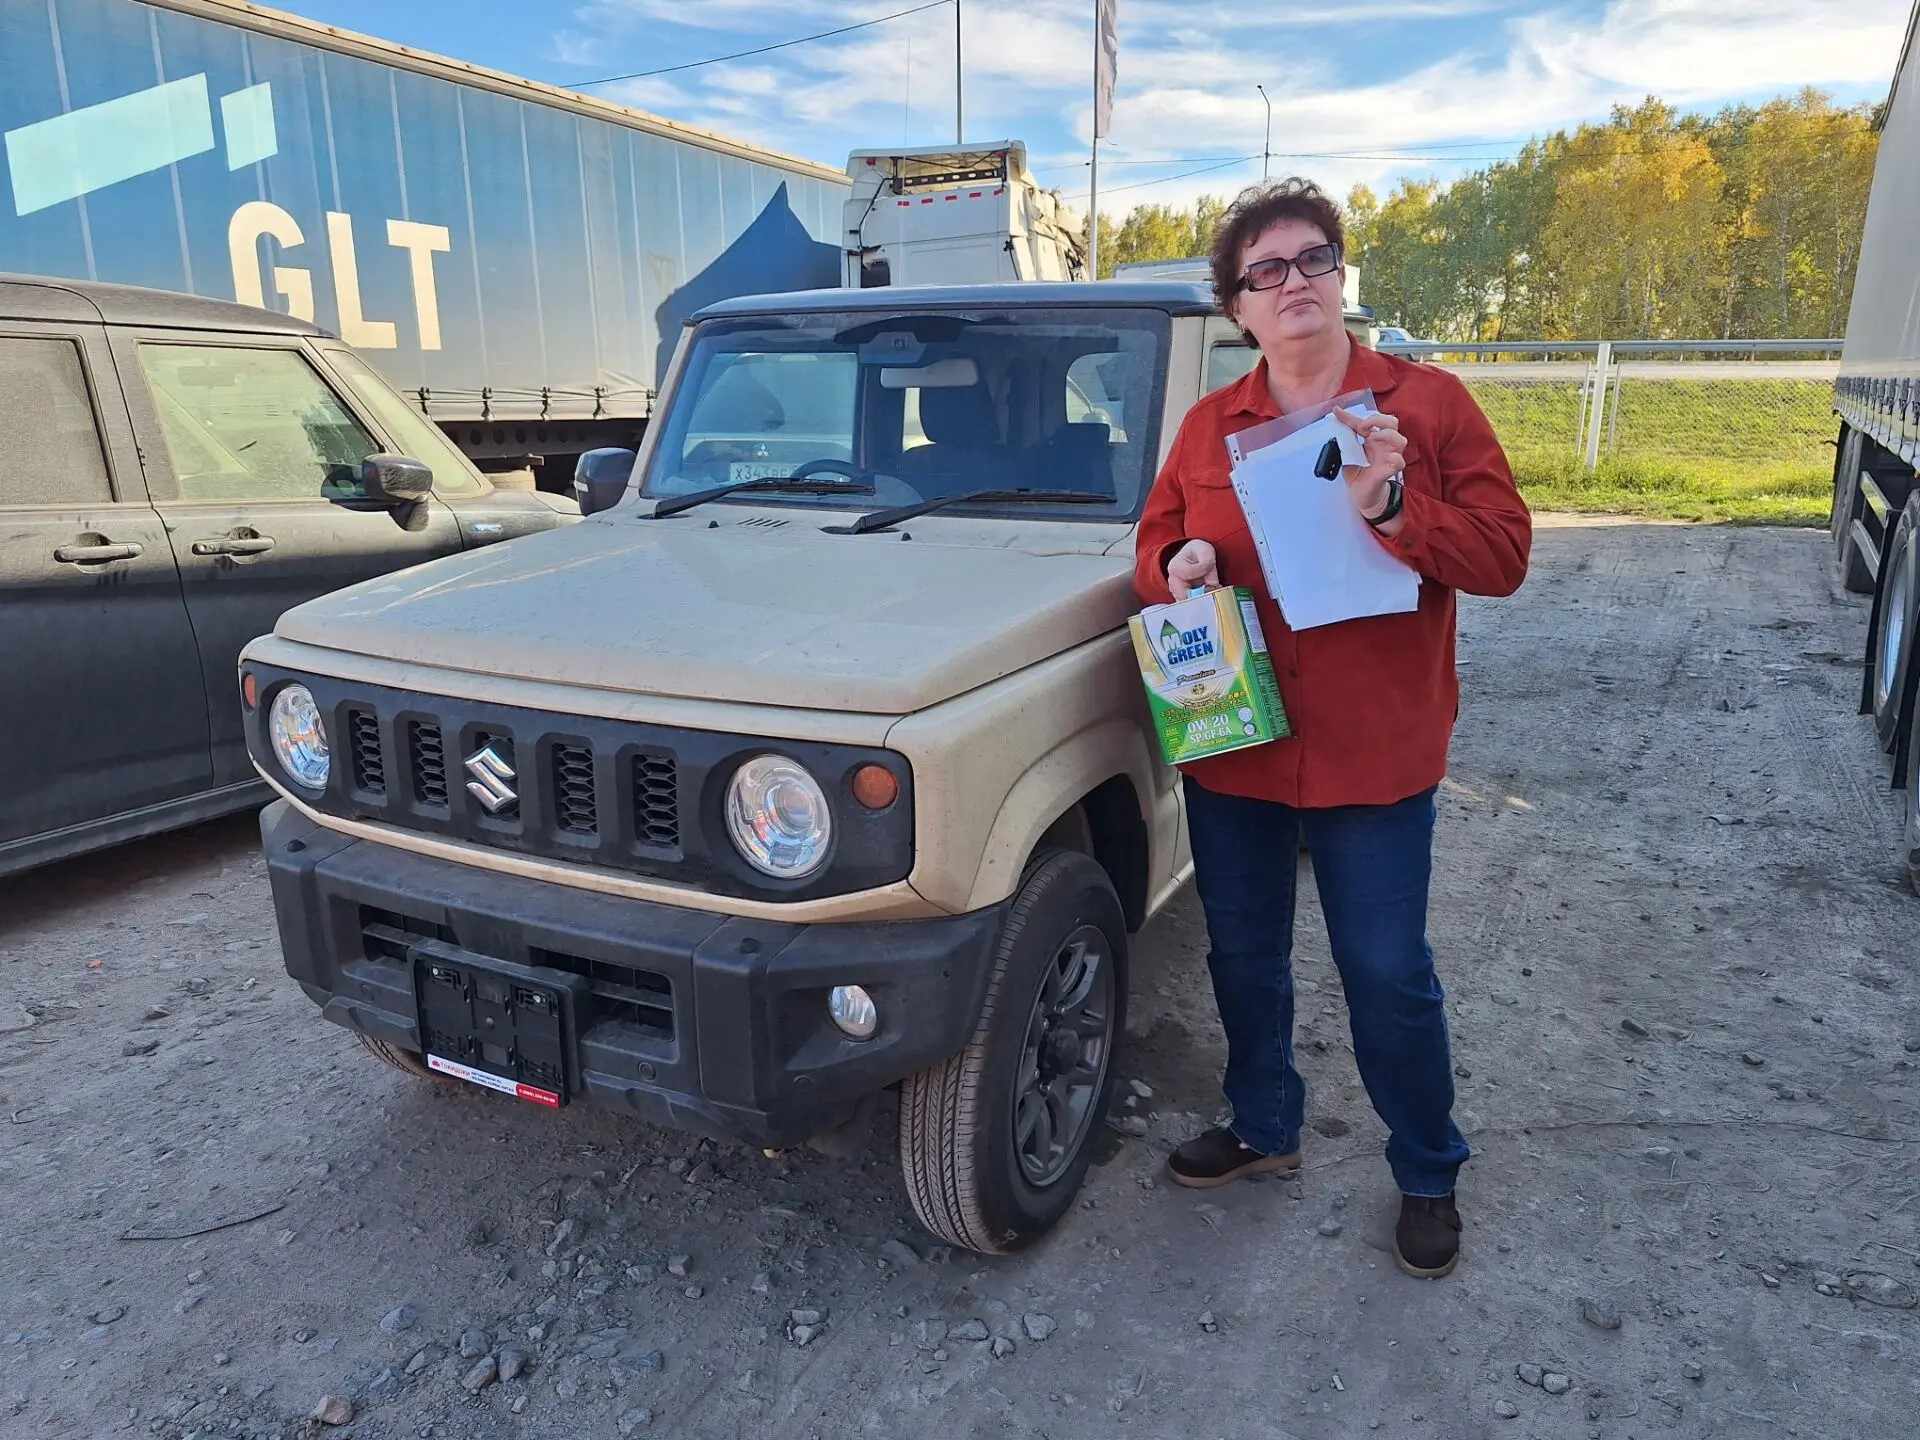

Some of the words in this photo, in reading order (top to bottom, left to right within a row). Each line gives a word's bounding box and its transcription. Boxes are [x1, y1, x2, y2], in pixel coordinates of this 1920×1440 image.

[228, 200, 451, 351] GLT
[1161, 625, 1208, 652] MOLY
[1167, 641, 1214, 665] GREEN
